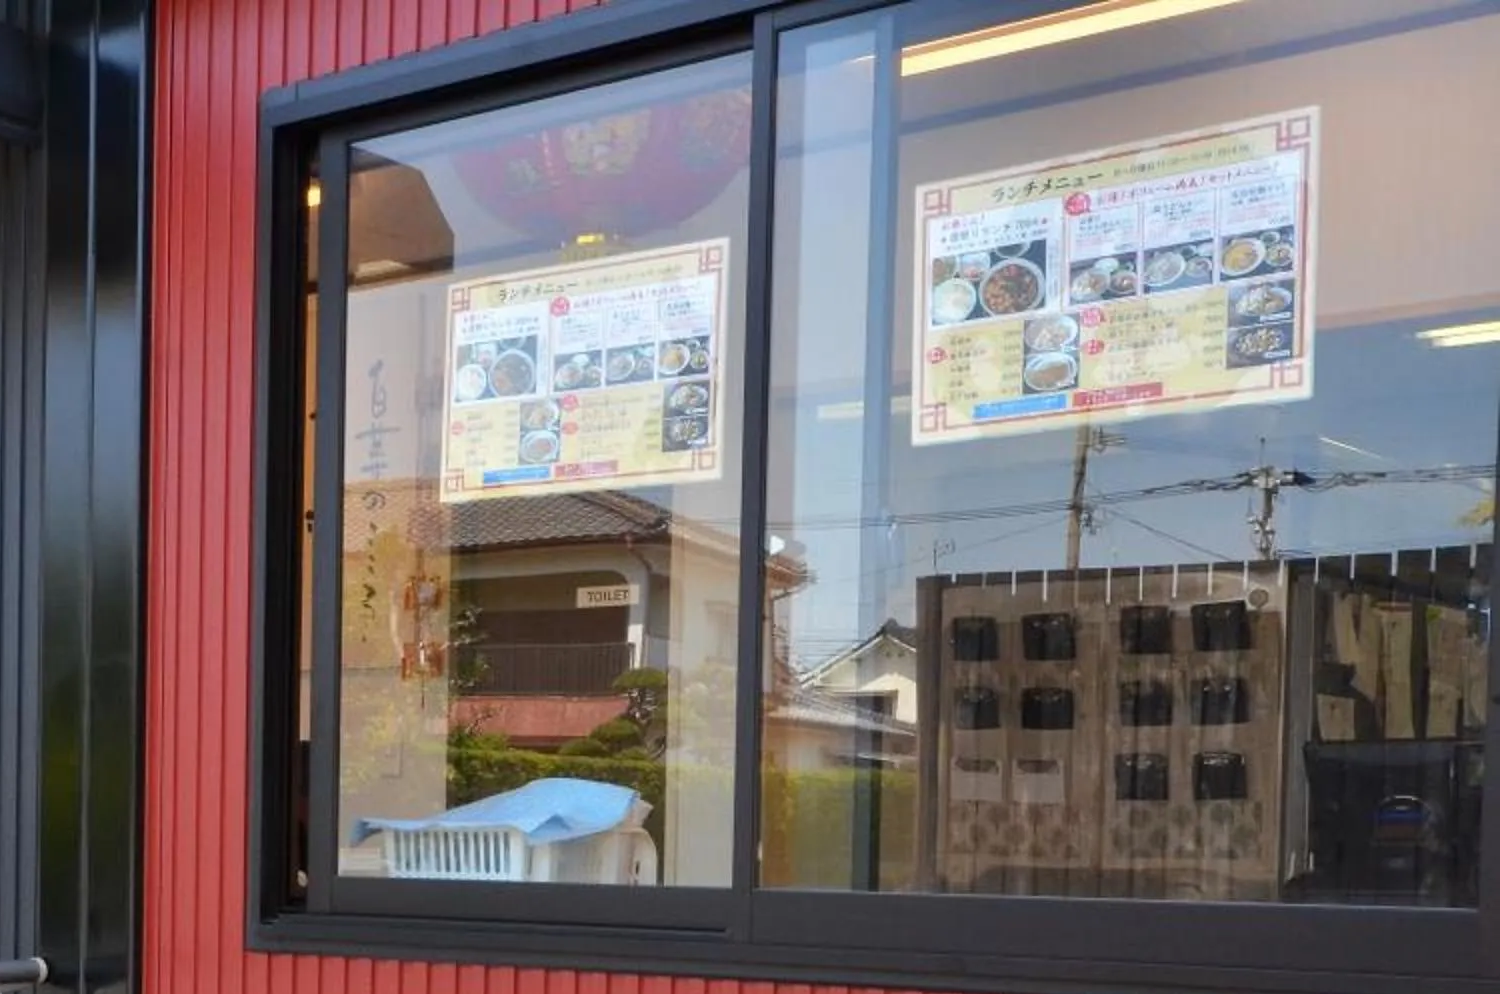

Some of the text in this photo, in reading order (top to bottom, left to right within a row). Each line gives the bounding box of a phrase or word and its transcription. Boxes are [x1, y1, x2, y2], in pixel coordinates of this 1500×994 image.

[992, 172, 1103, 202] ランチメニュー
[588, 589, 629, 602] TOILET
